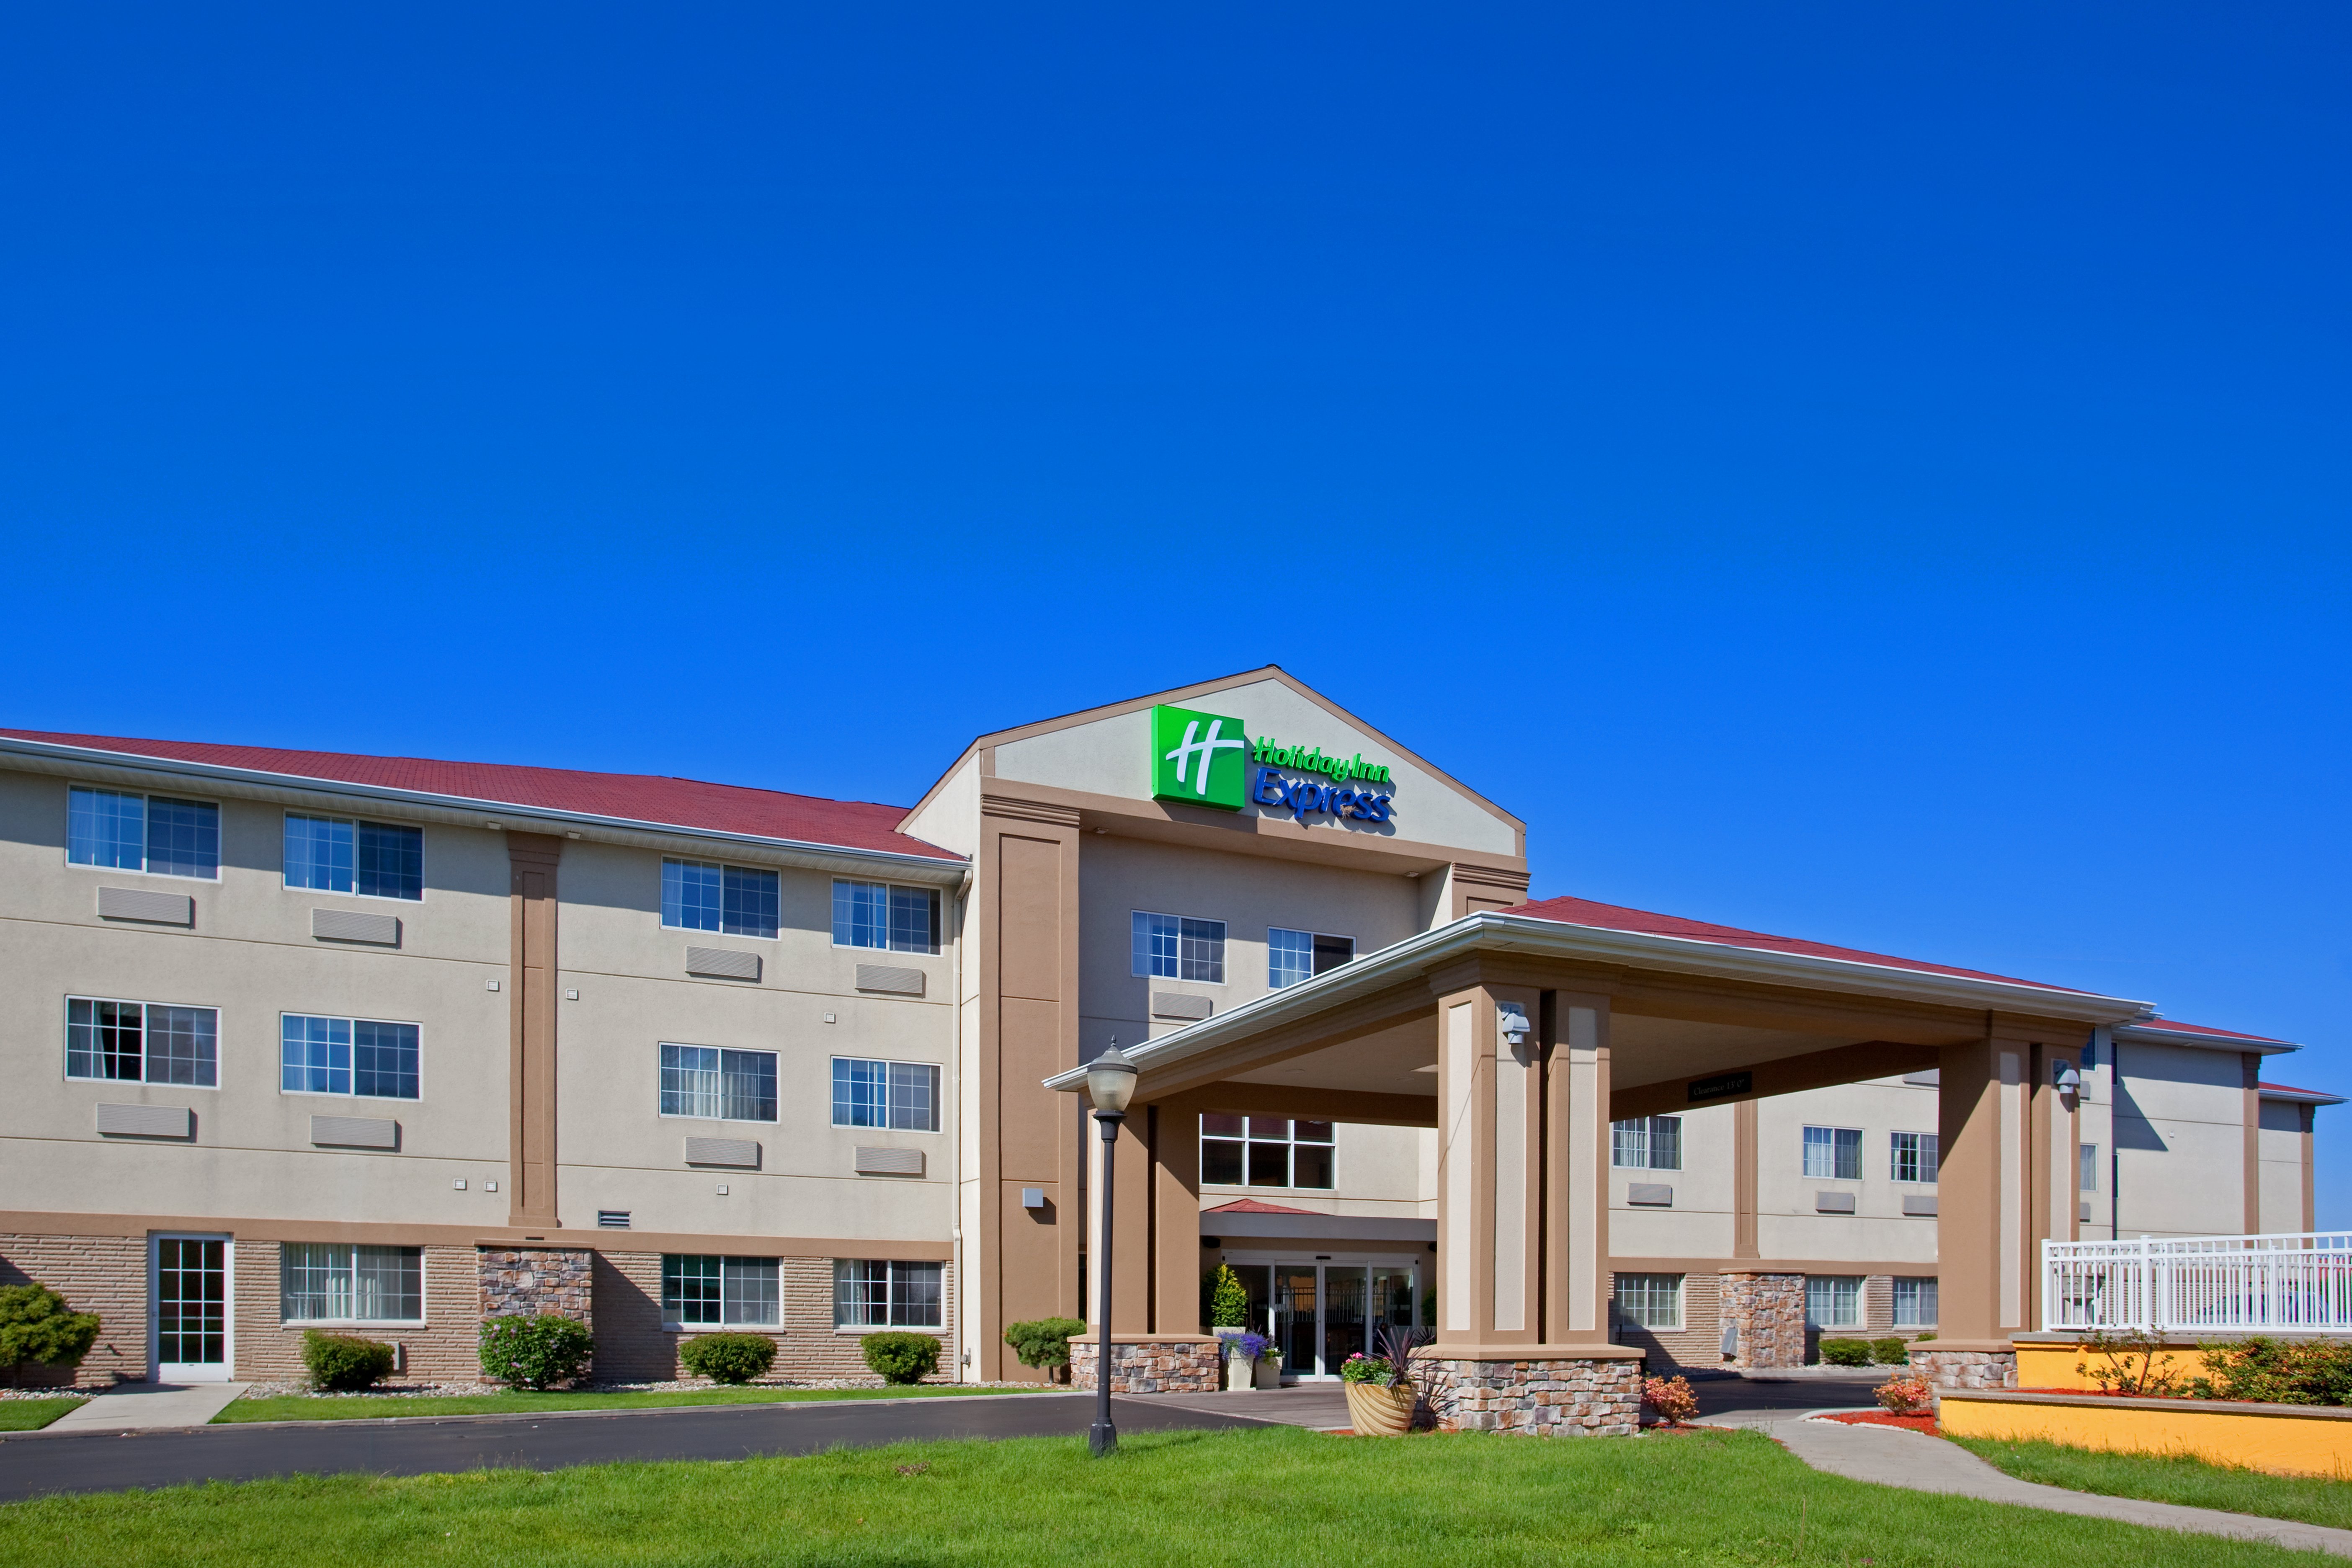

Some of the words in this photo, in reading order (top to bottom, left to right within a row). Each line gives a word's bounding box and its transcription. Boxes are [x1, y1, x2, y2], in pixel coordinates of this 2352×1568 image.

[1166, 720, 1244, 795] H
[1252, 736, 1349, 781] Holiday
[1350, 753, 1389, 783] Inn
[1252, 767, 1390, 823] Express
[1694, 1086, 1724, 1096] Clearance
[1727, 1081, 1736, 1089] 13'
